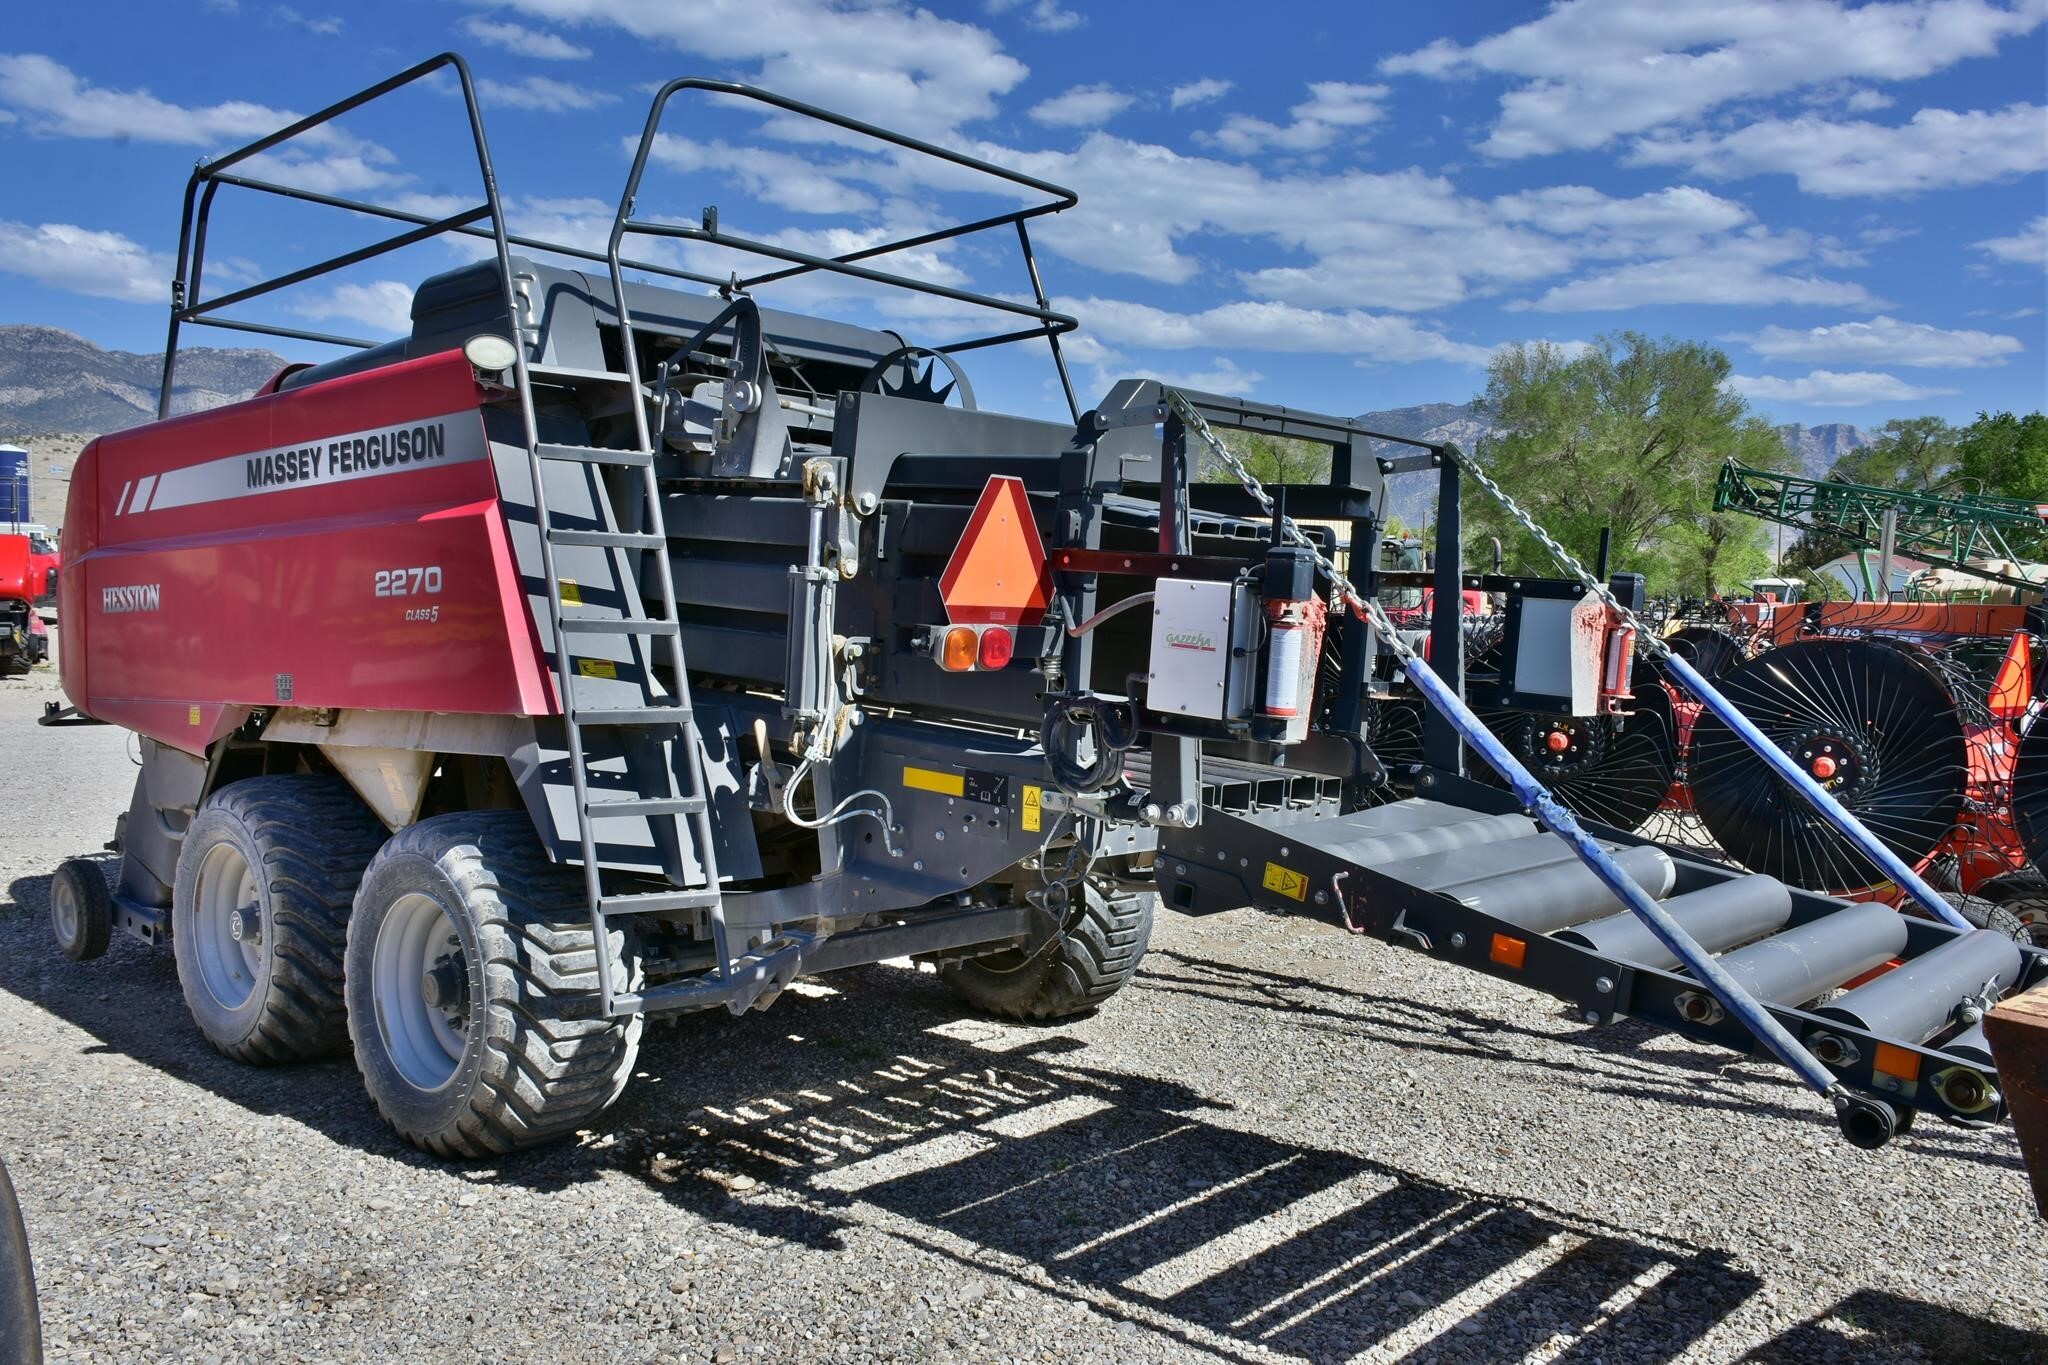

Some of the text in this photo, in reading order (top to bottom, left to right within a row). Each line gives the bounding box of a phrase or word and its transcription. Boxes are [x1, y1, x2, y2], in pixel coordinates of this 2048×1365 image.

[247, 423, 445, 488] MASSEY FERGUSON
[375, 566, 443, 597] 2270
[102, 583, 160, 613] HESSTON
